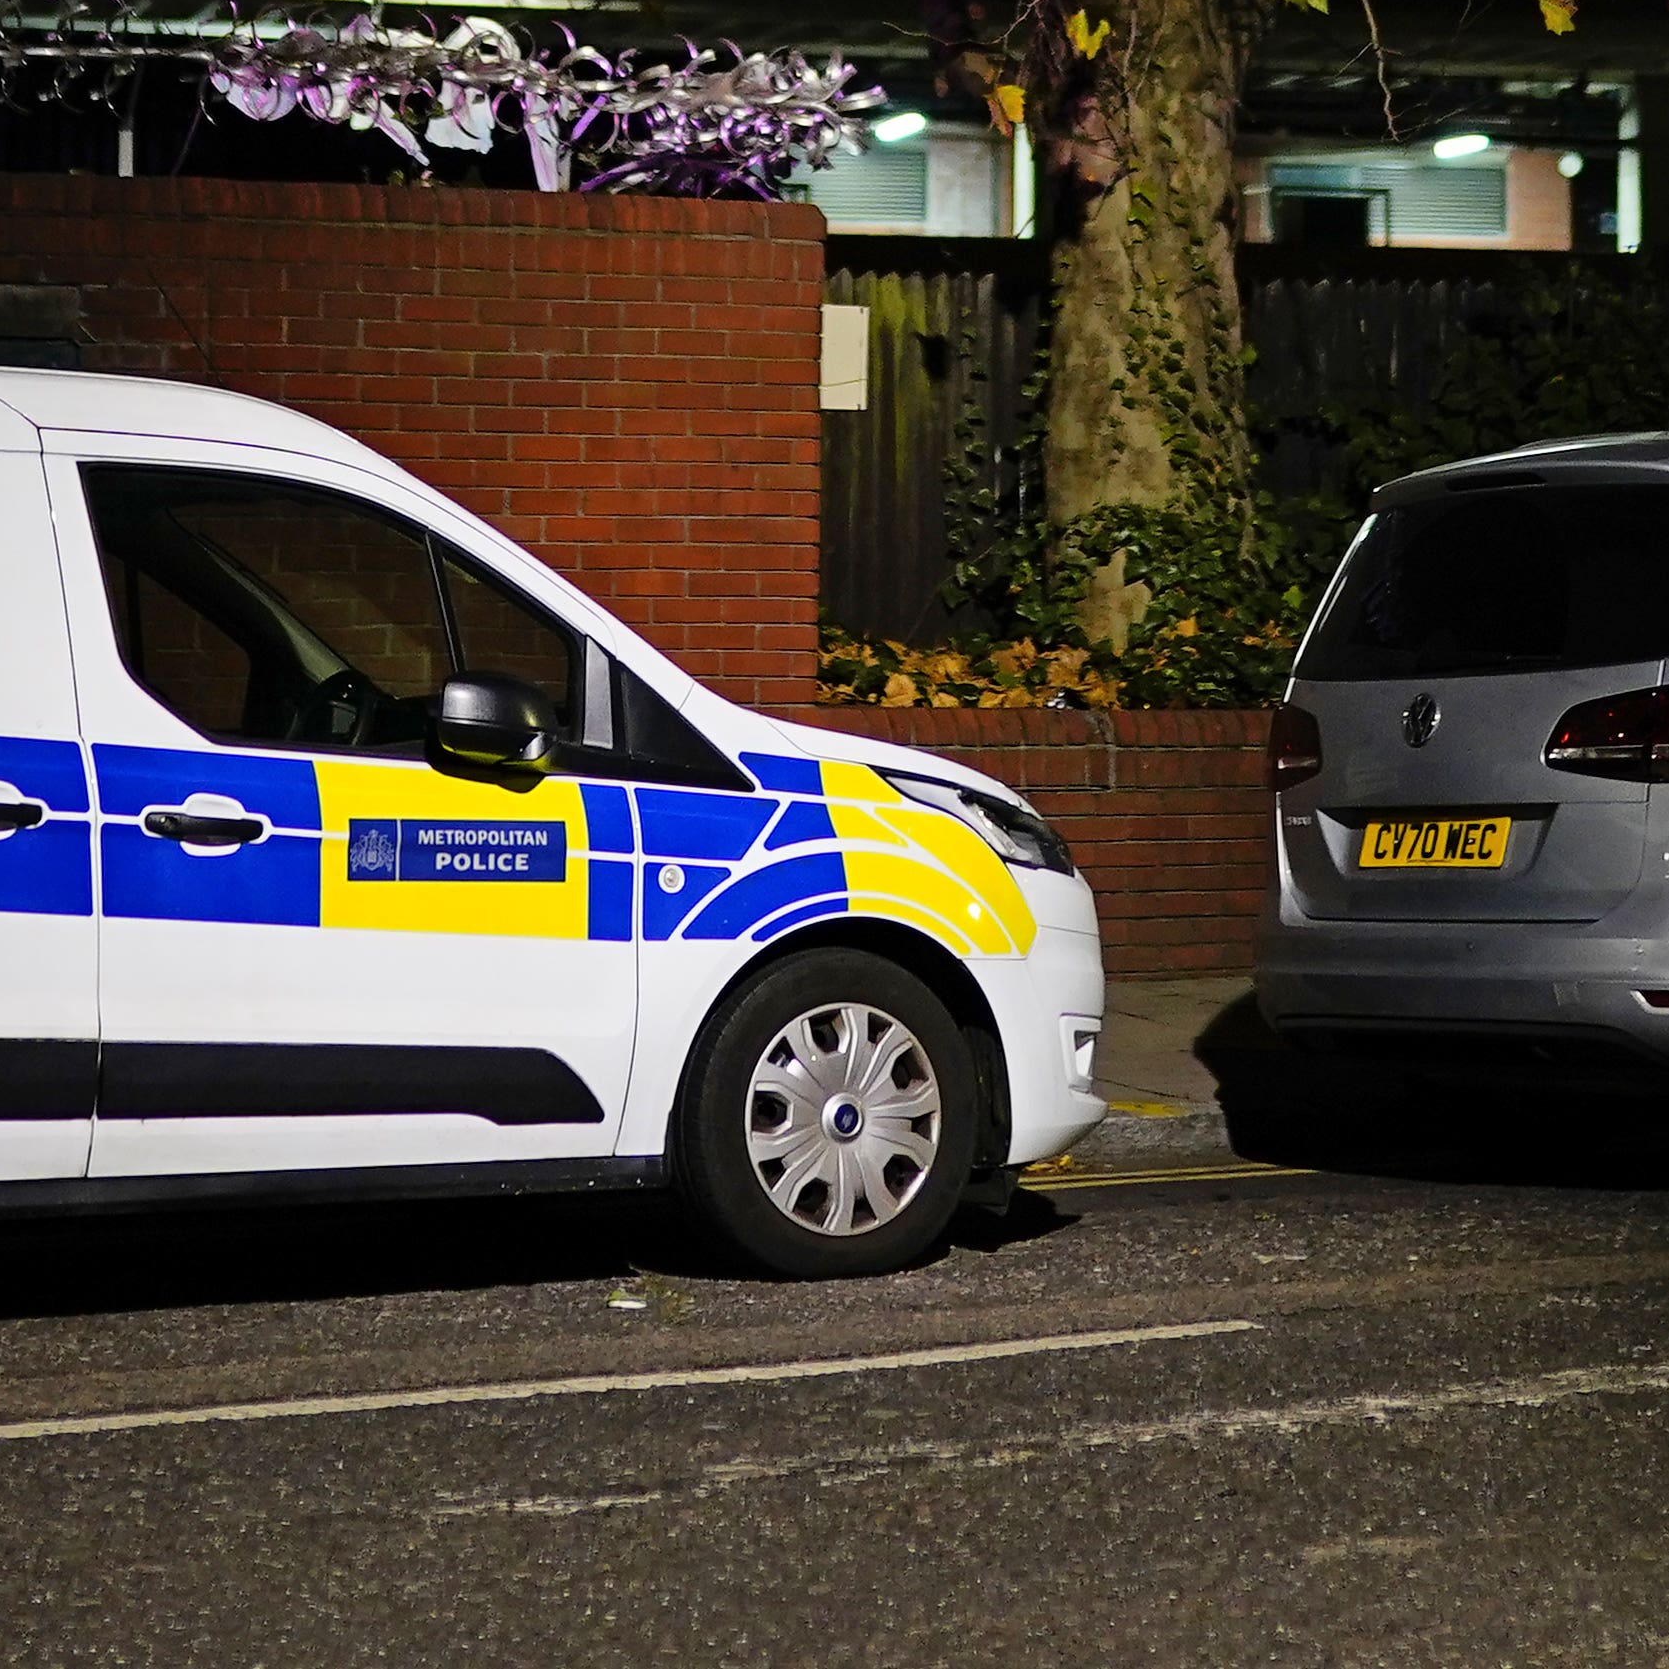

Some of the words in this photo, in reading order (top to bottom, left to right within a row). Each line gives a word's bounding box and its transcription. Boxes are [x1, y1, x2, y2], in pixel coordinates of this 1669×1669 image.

[418, 829, 548, 846] METROPOLITAN
[1373, 822, 1439, 860] CV70
[1443, 822, 1497, 860] WEC
[435, 852, 529, 872] POLICE
